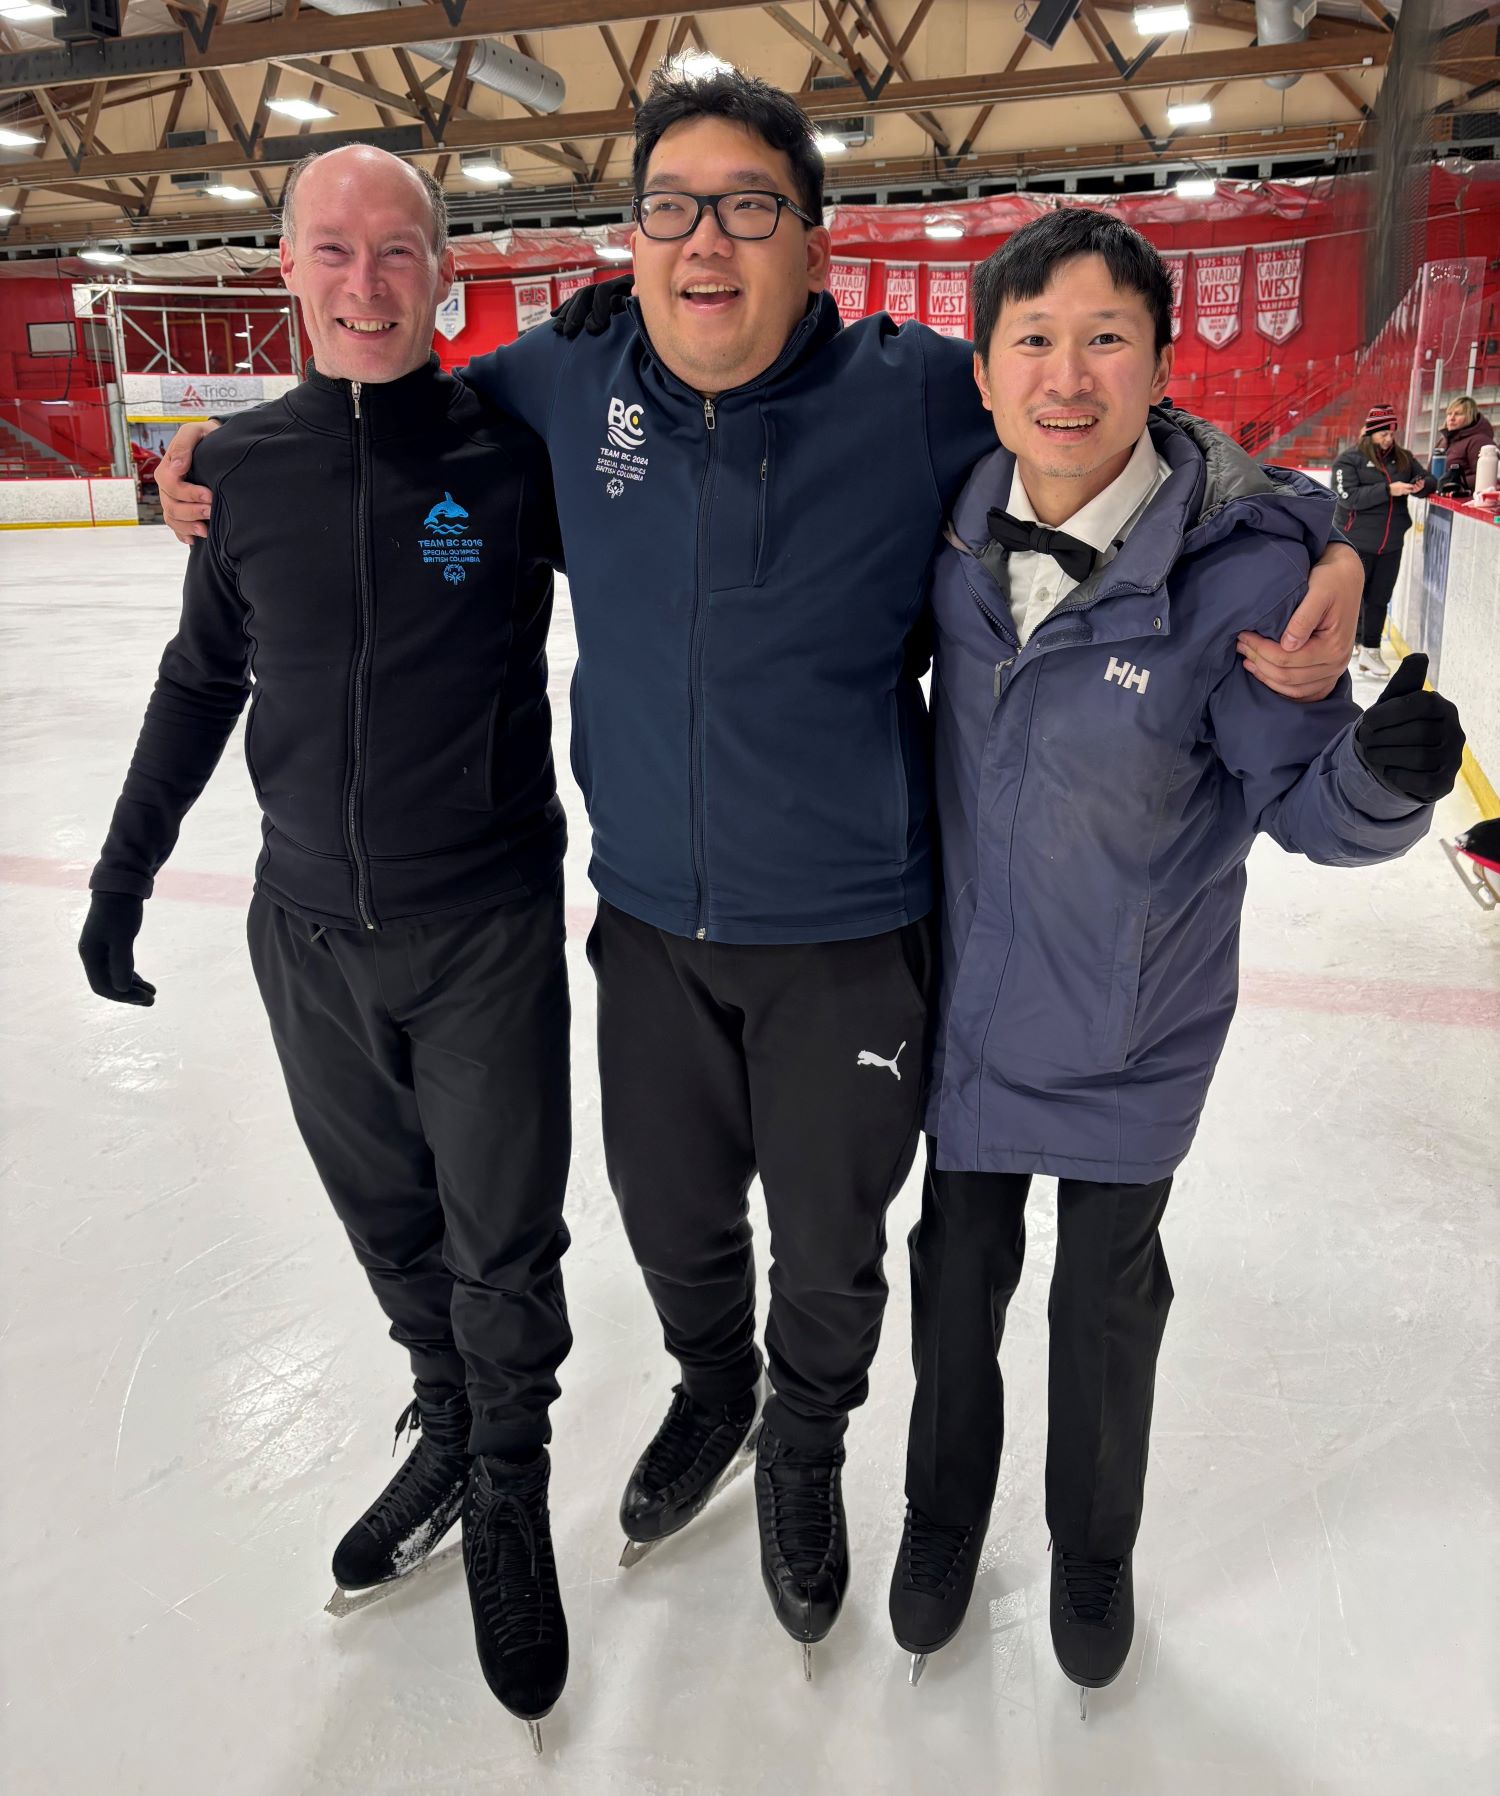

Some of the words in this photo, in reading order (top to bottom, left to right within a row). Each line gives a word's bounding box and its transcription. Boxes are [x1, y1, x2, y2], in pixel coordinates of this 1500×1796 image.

[1198, 267, 1239, 283] CANADA
[1258, 260, 1300, 278] CANADA
[831, 275, 865, 289] CANADA
[889, 280, 913, 293] CANADA
[932, 281, 965, 295] CANADA
[1259, 277, 1299, 298] WEST
[831, 288, 863, 307] WEST
[1200, 283, 1239, 304] WEST
[888, 294, 913, 312] WEST
[932, 295, 964, 313] WEST
[1198, 305, 1239, 315] CHAMPIONS
[1258, 300, 1299, 311] CHAMPIONS
[929, 317, 966, 326] CHAMPIONS
[201, 384, 238, 398] Trico
[607, 396, 645, 437] BC
[600, 447, 620, 459] TEAM
[620, 452, 631, 462] BC
[632, 455, 649, 466] 2024
[595, 464, 617, 475] BRITISH
[616, 470, 644, 481] COLUMBIA
[597, 457, 618, 469] SPECIAL
[619, 463, 646, 475] OLYMPICS
[417, 539, 444, 548] TEAM
[446, 539, 460, 547] BC
[461, 539, 483, 547] 2016
[1104, 656, 1151, 694] HH
